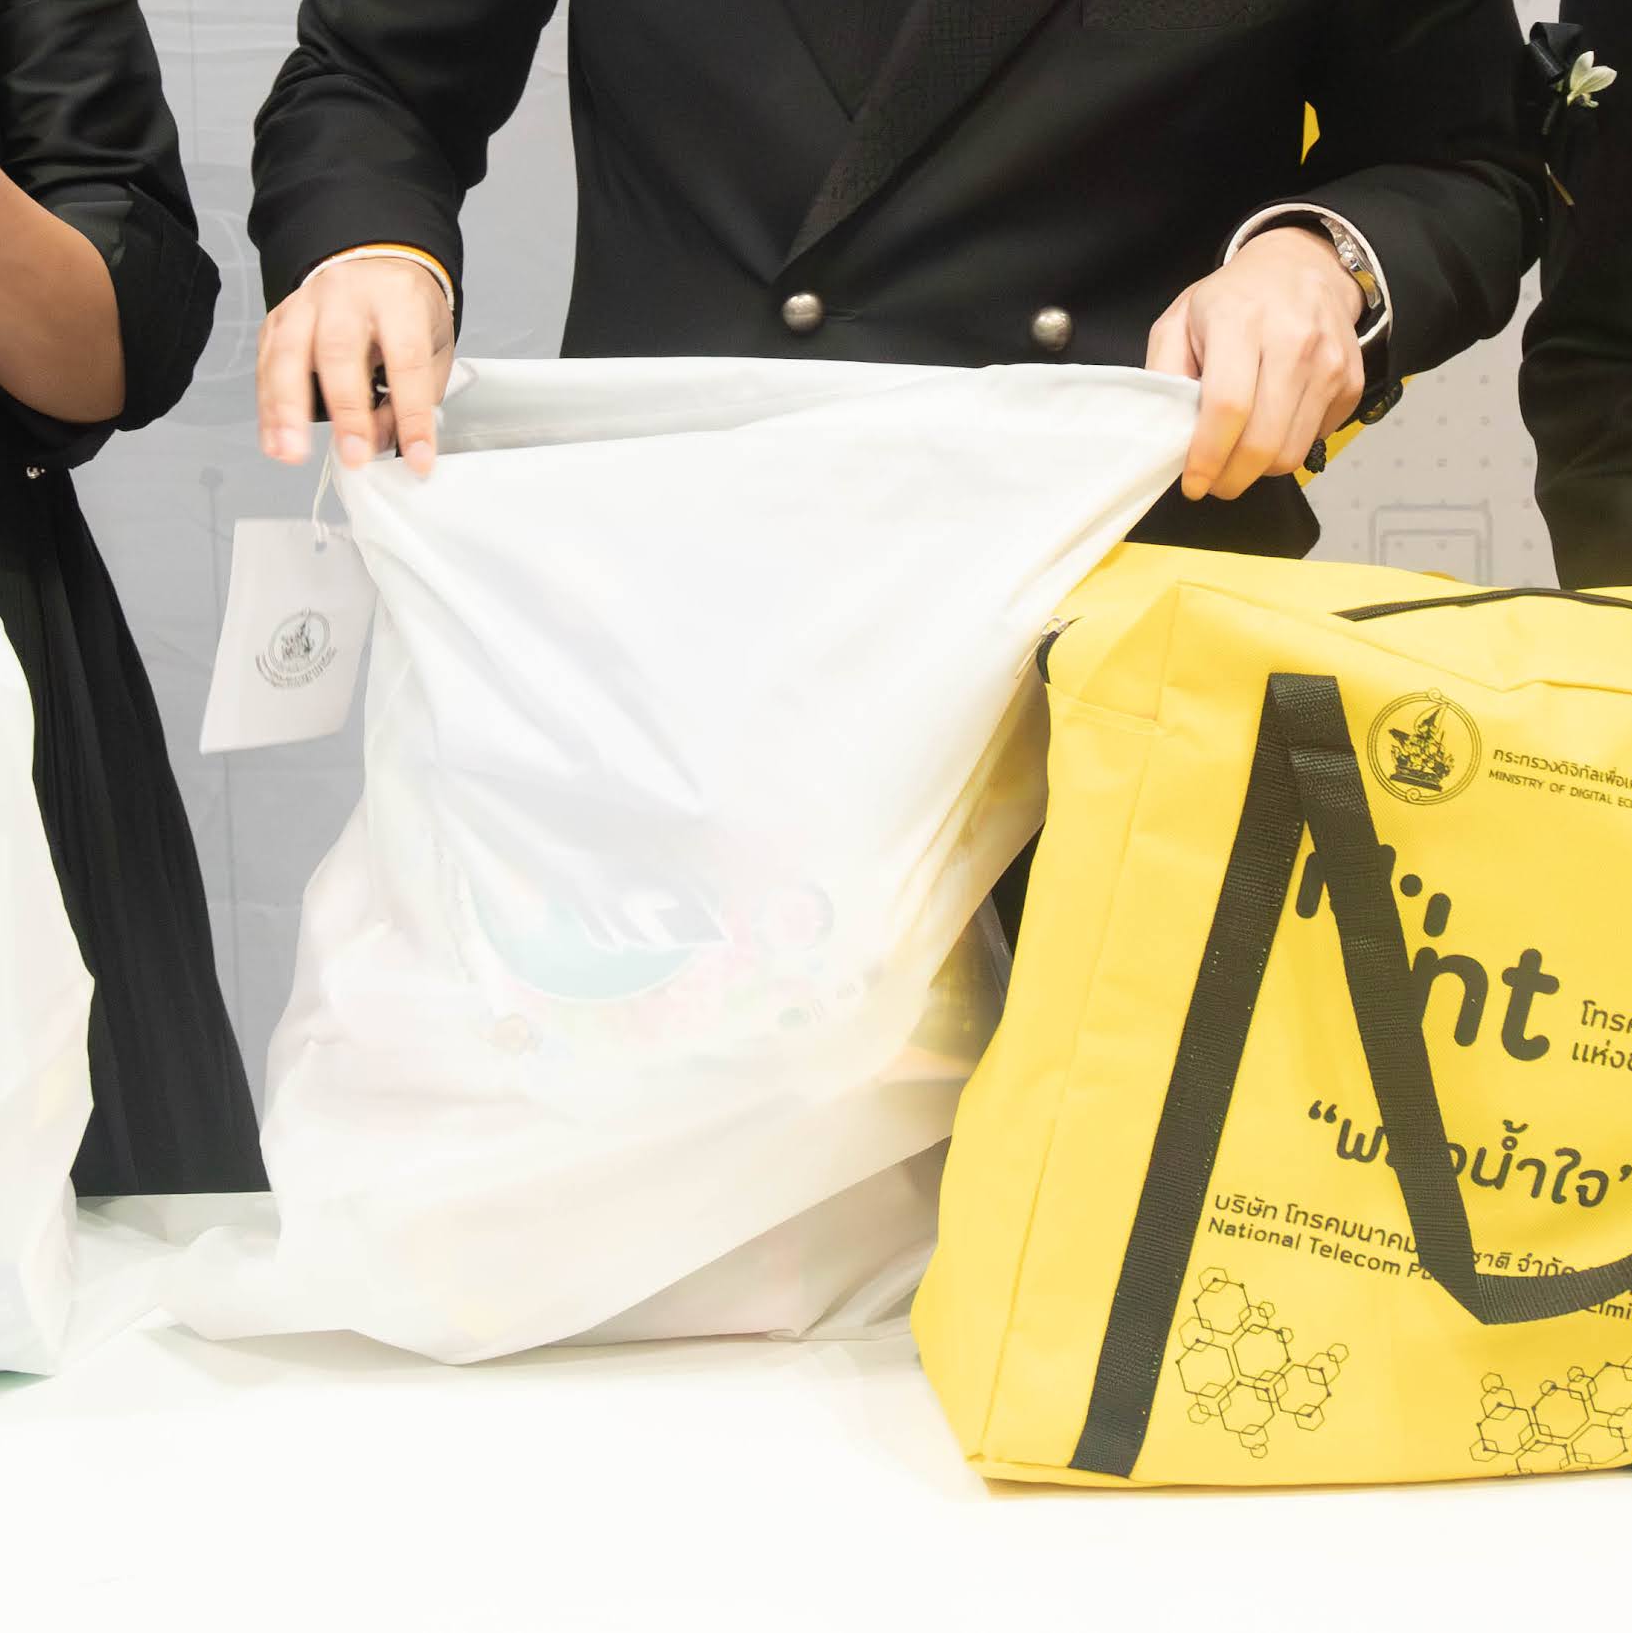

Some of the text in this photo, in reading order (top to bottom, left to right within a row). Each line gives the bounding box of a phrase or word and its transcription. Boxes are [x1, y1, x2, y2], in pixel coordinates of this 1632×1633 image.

[1489, 769, 1544, 790] MINISTRY
[1549, 782, 1566, 795] OF
[1570, 786, 1613, 805] DIGITAL
[1412, 947, 1560, 1062] nt
[1214, 1194, 1278, 1220] บริษัท
[1208, 1217, 1302, 1251] National
[1308, 1237, 1402, 1276] Telecom
